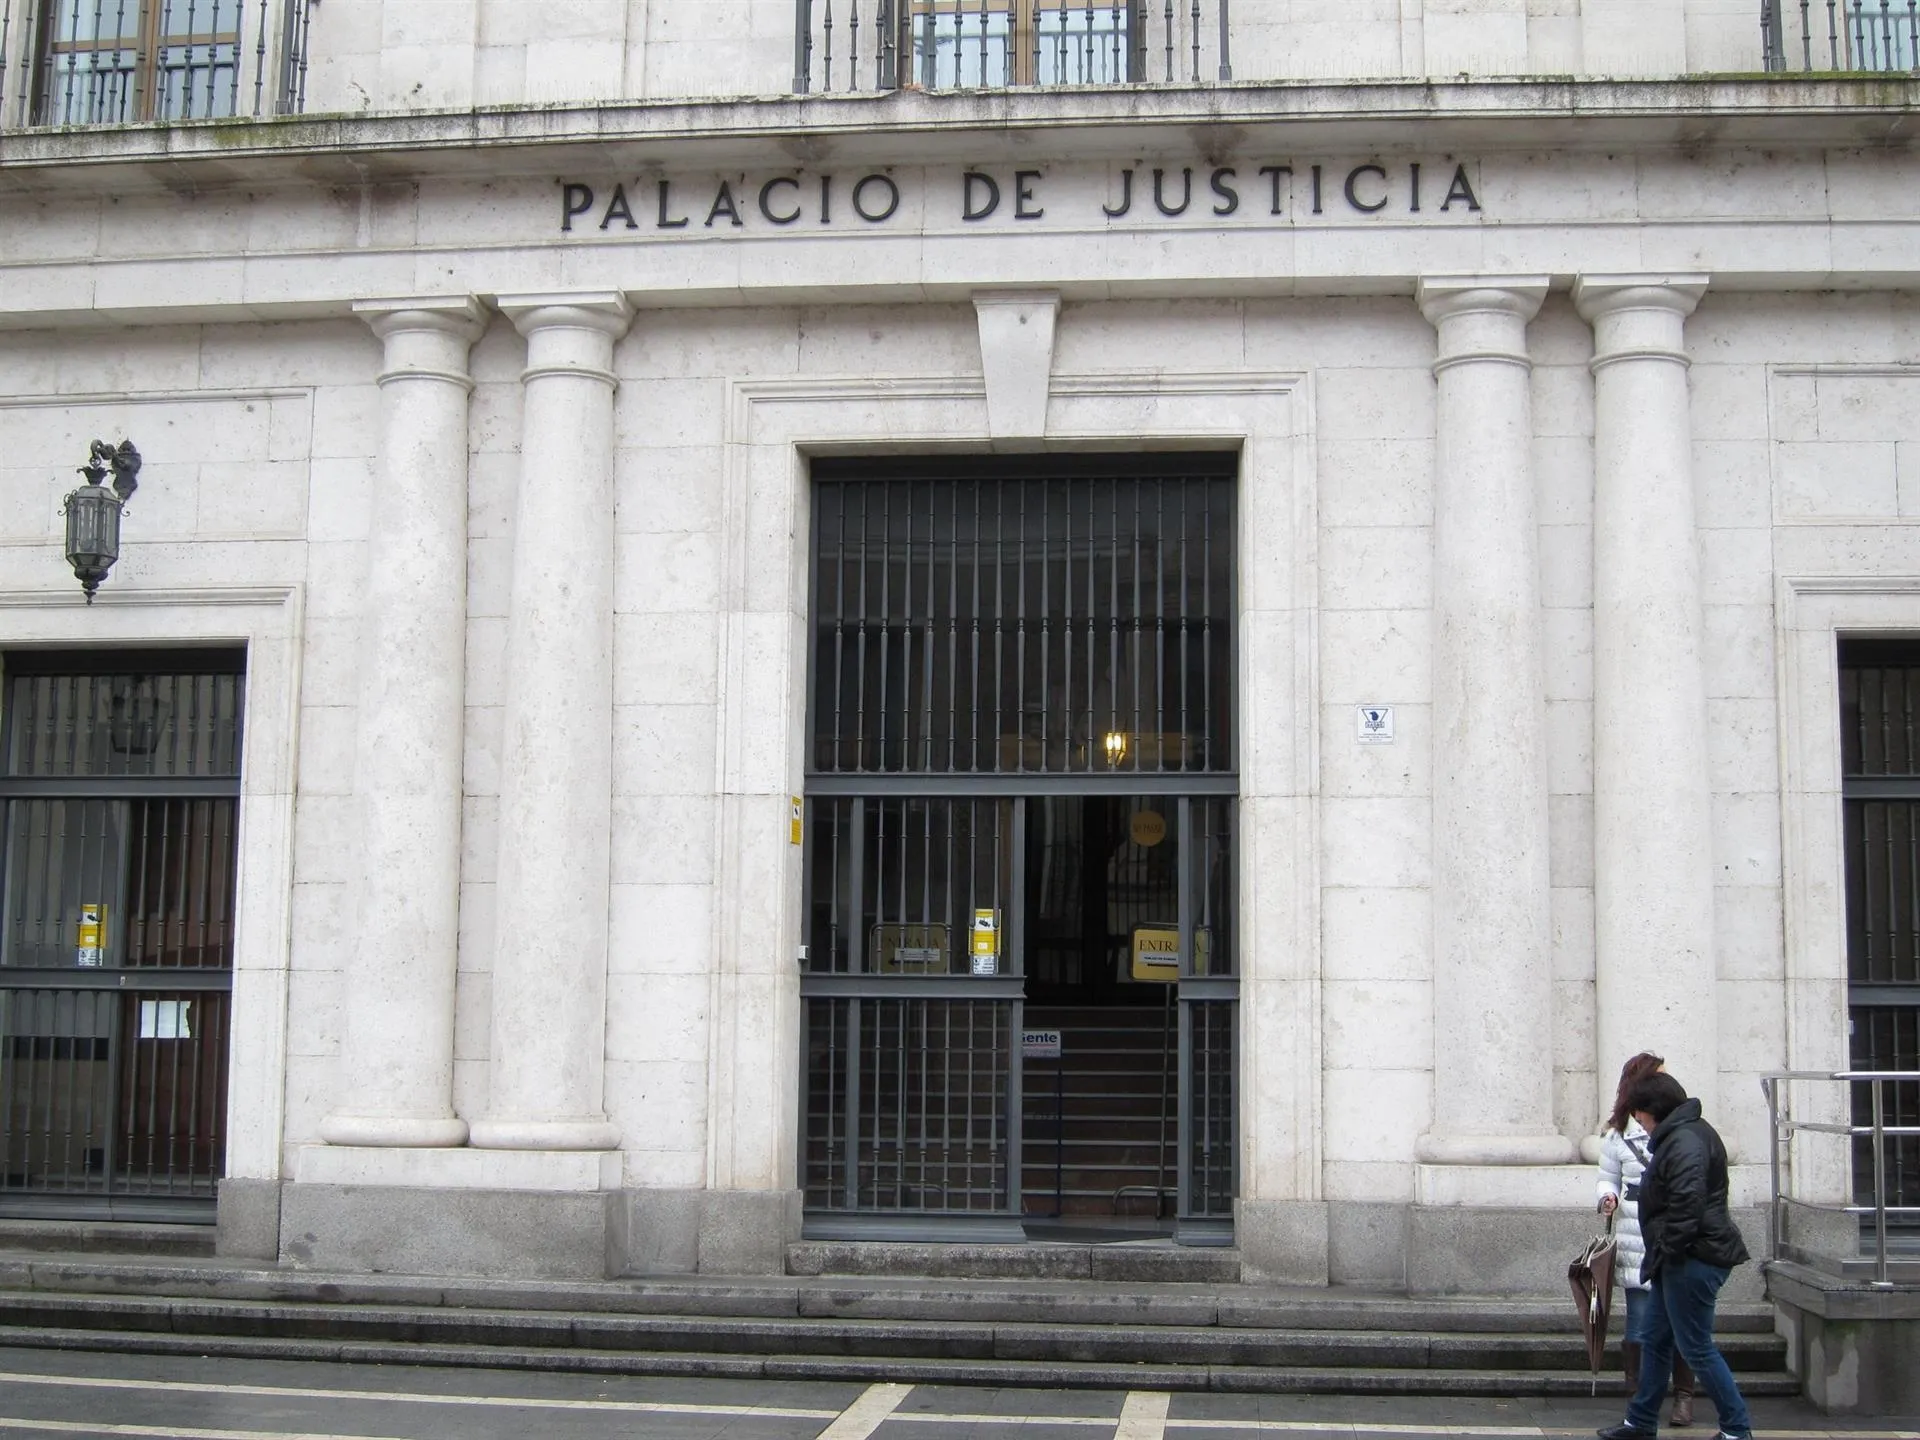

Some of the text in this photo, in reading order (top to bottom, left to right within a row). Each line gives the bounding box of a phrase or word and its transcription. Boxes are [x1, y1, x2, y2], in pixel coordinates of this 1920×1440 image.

[561, 163, 1481, 231] PALACIO DE JUSTICIA
